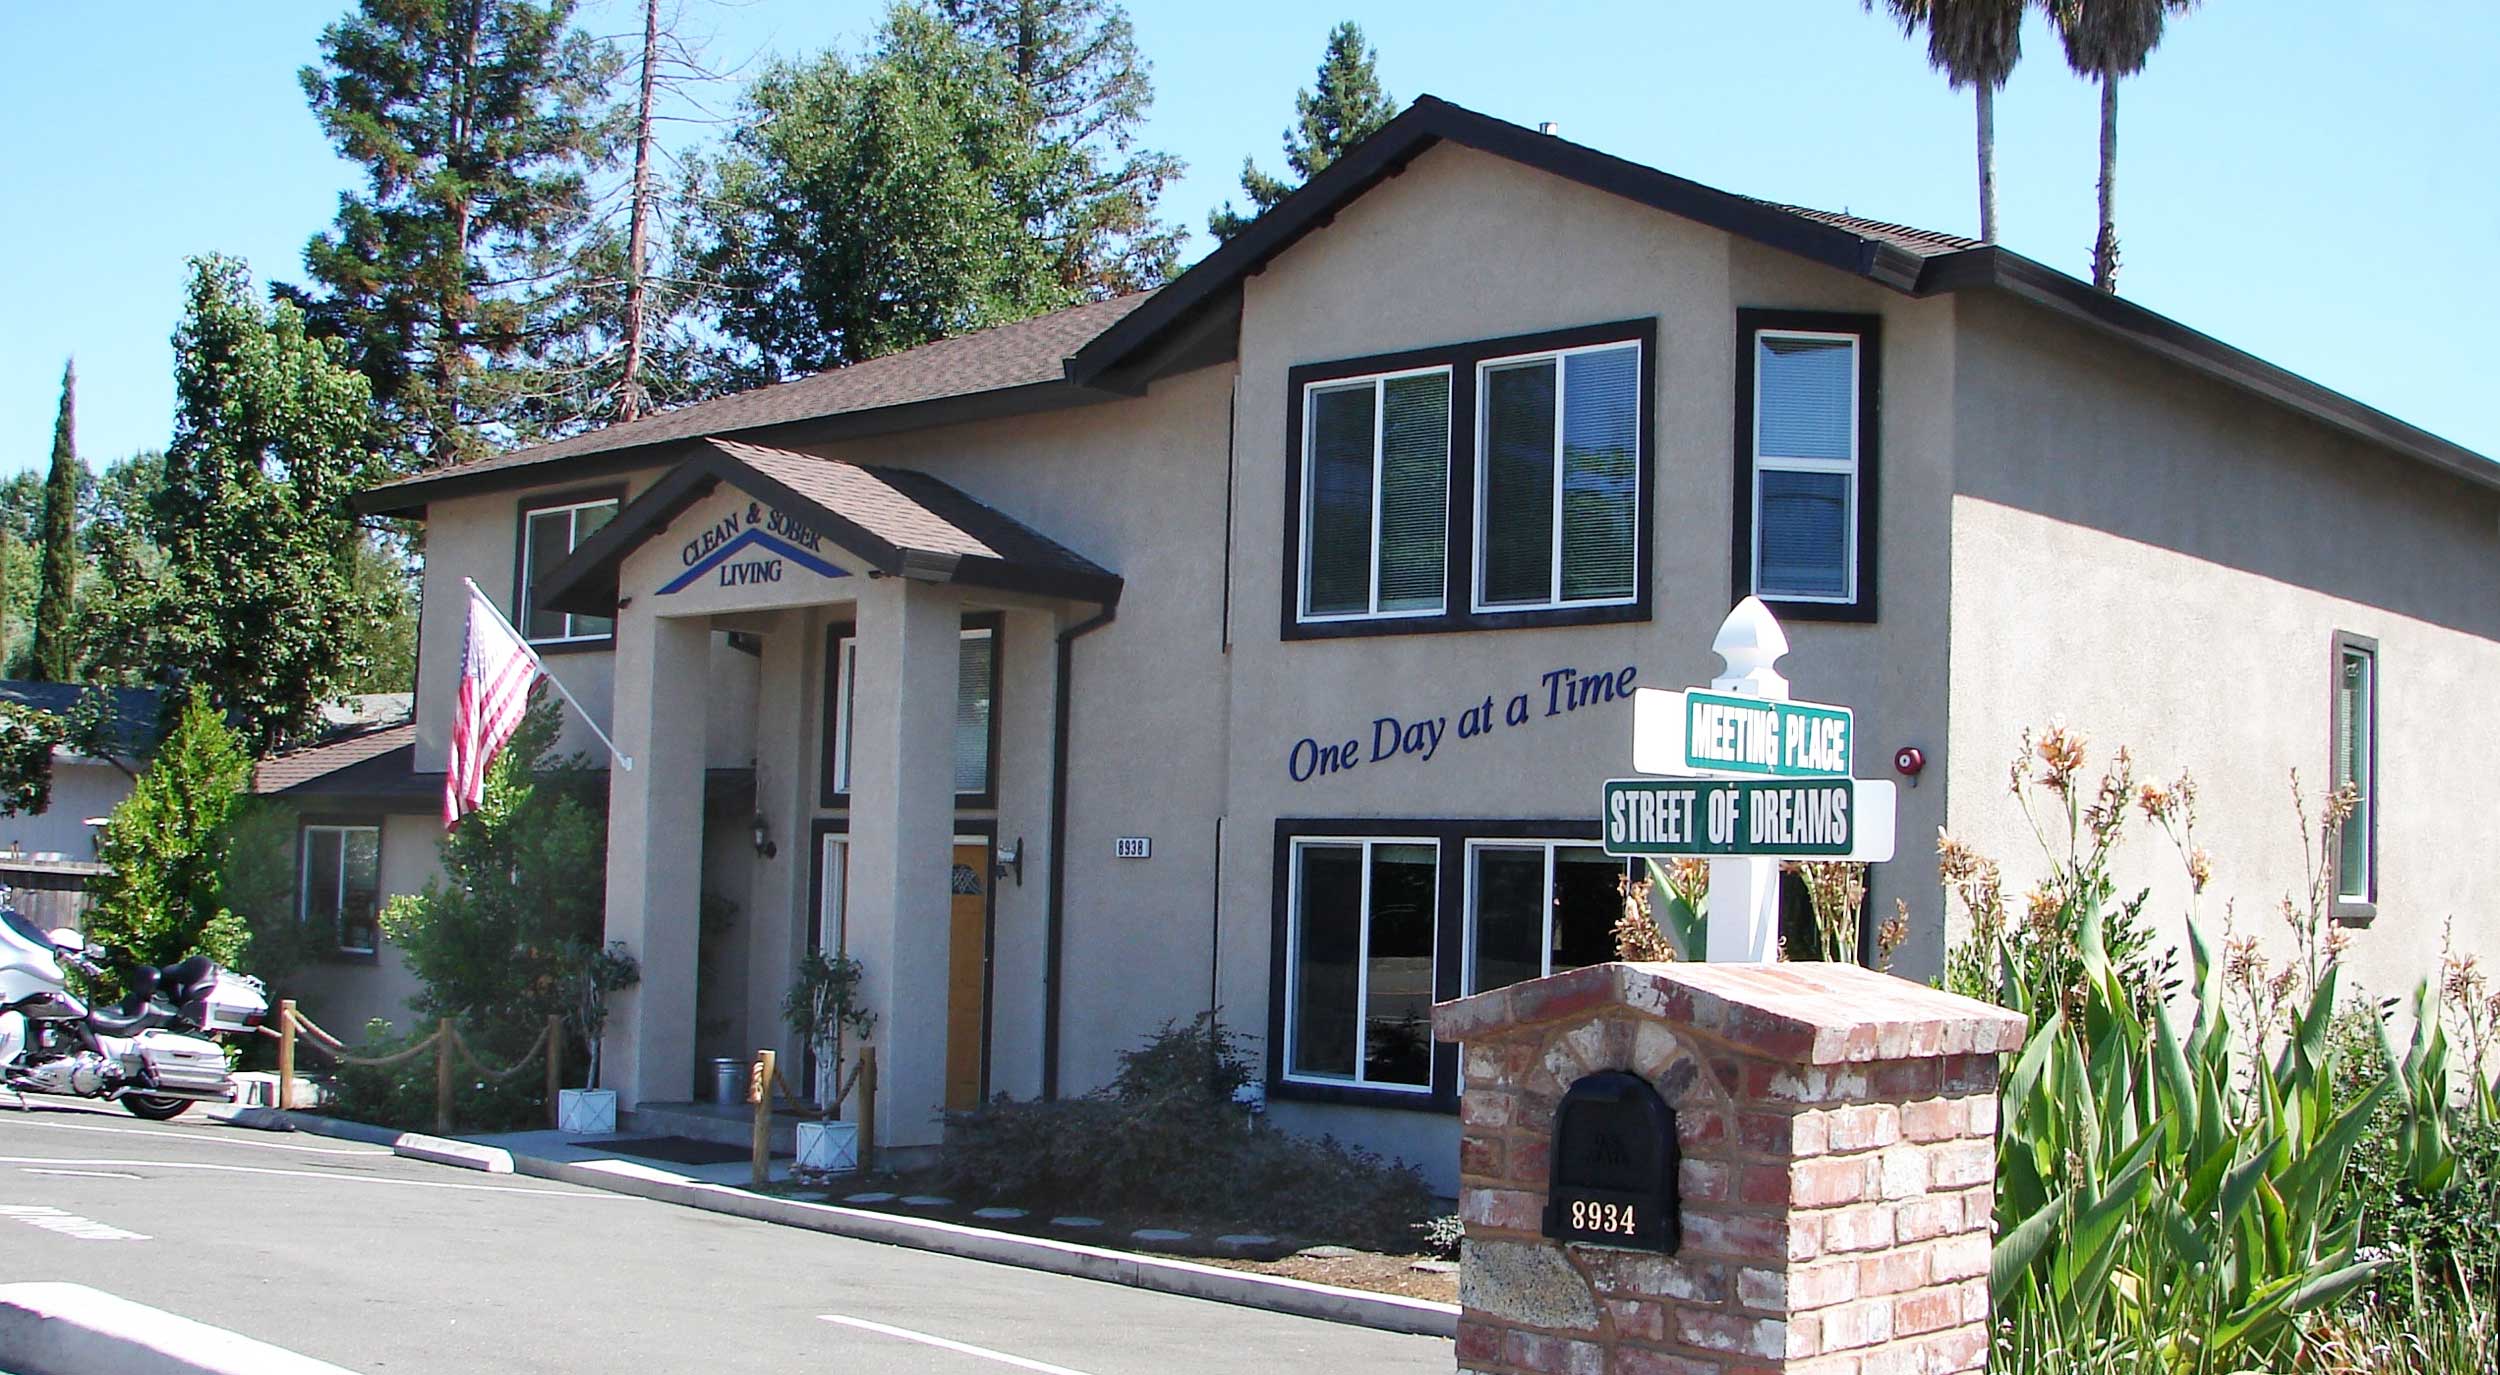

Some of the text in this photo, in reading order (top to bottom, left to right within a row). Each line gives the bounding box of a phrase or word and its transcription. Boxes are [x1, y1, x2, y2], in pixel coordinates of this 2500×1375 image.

[682, 502, 822, 567] CLEAN & SOBER
[719, 559, 783, 587] LIVING
[1288, 665, 1638, 783] One Day at a Time
[1691, 702, 1846, 772] MEETING PLACE
[1610, 787, 1848, 846] STREET OF DREAMS
[1571, 1200, 1636, 1236] 8934
